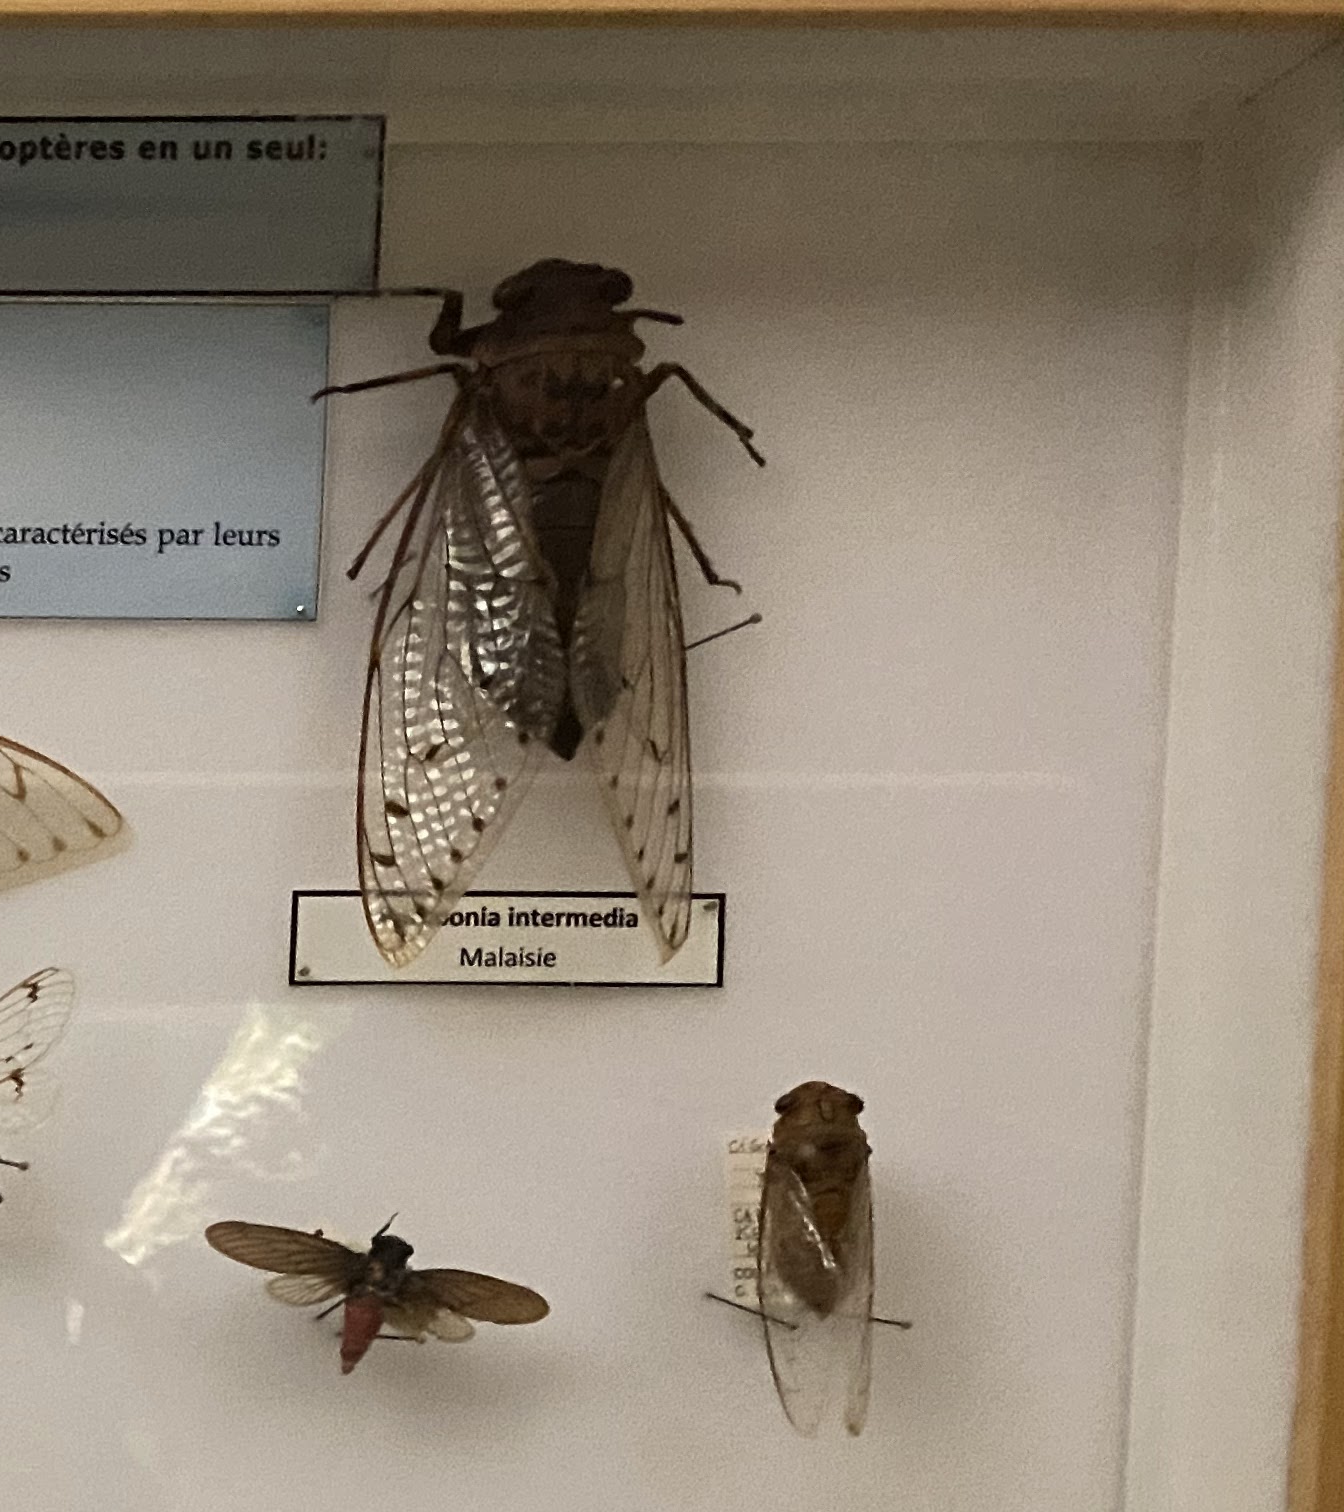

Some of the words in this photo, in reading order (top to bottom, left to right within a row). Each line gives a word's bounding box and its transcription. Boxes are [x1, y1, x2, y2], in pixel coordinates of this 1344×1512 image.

[137, 142, 179, 162] en
[192, 142, 233, 162] un
[246, 135, 327, 162] seul:
[157, 527, 205, 555] par
[213, 518, 281, 547] leurs
[508, 907, 639, 930] intermedia
[459, 946, 557, 969] Malaisie
